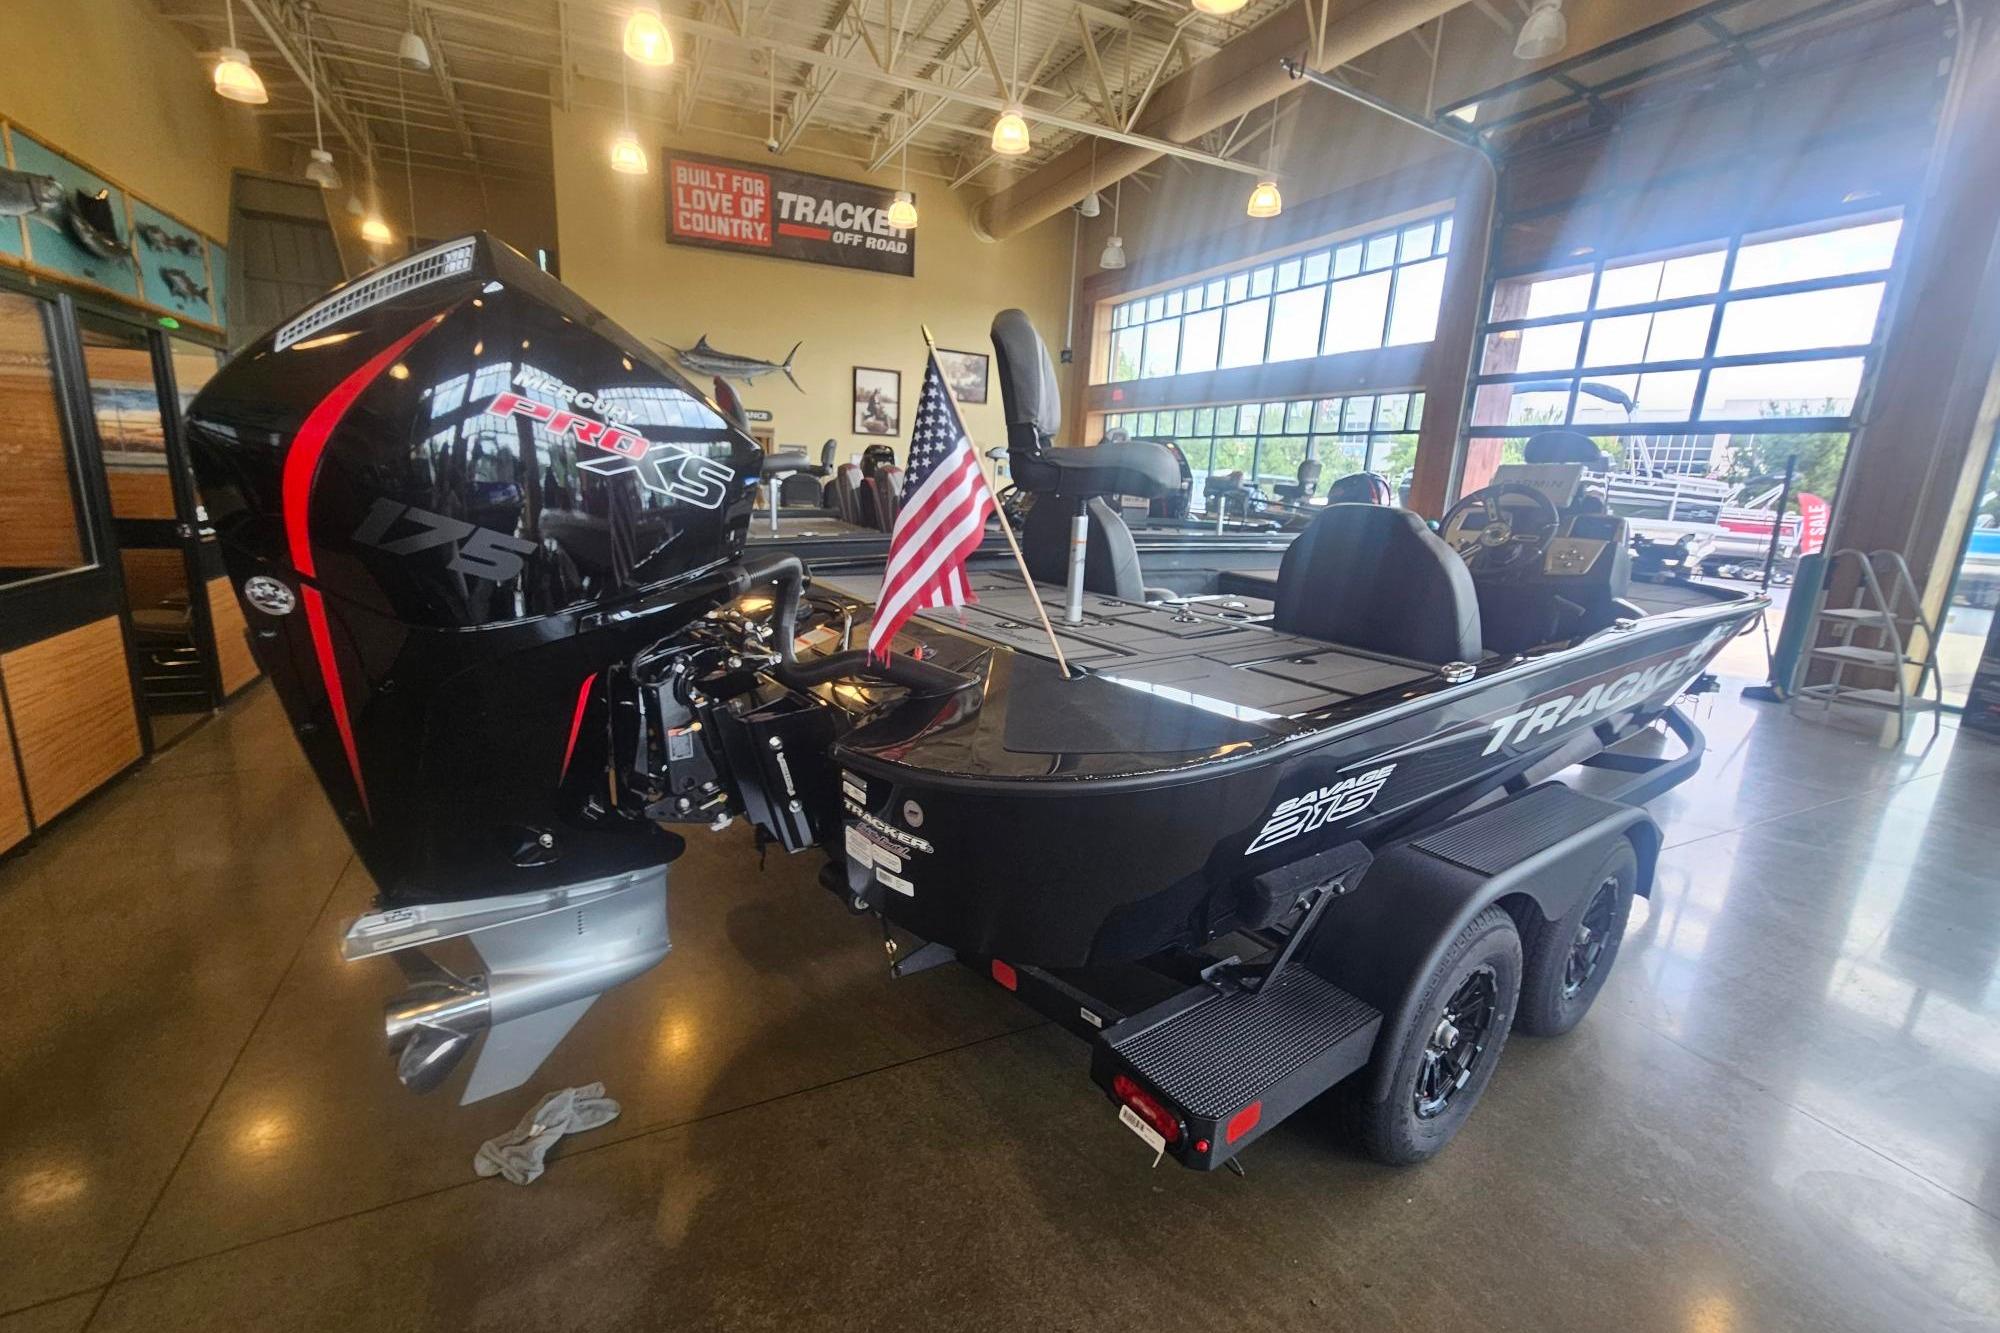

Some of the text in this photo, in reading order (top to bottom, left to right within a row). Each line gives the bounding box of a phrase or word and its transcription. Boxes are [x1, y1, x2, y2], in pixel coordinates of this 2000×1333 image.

[676, 166, 765, 197] BUILT FOR
[677, 188, 765, 219] LOVE OF
[679, 211, 769, 241] COUNTRY.
[832, 230, 908, 255] OFF ROAD
[512, 369, 646, 424] MERCURY
[487, 391, 736, 510] PRO XS
[351, 497, 538, 581] 175
[1808, 504, 1826, 536] SALE
[1481, 648, 1706, 757] TRACKER
[1272, 763, 1397, 817] SAVAGE
[843, 797, 931, 852] TRACKER
